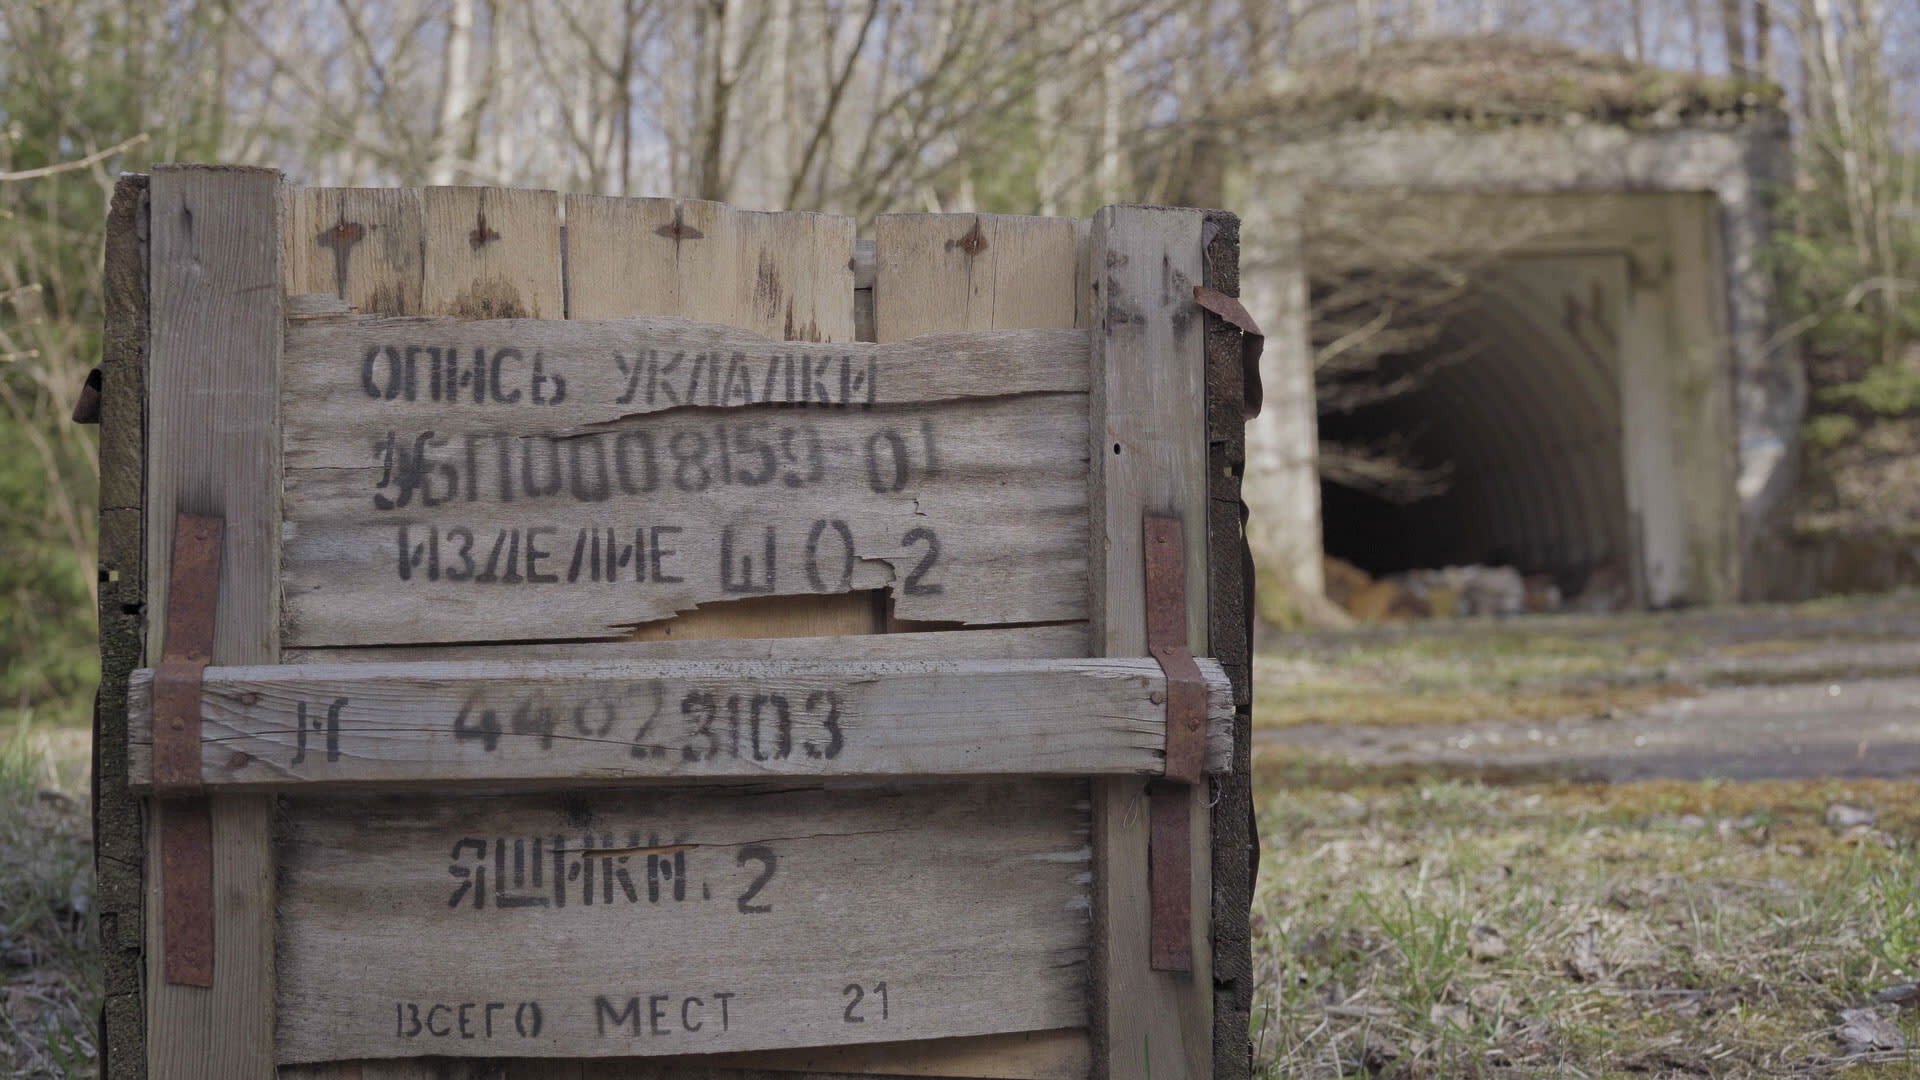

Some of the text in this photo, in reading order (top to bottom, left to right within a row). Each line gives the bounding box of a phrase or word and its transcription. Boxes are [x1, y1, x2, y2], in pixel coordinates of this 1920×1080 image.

[362, 344, 568, 406] ОПИСЬ
[398, 524, 684, 584] ИЗДЕЛИЕ
[736, 844, 778, 914] 2
[398, 980, 889, 1040] ВСЕГО МЕСТ 21
